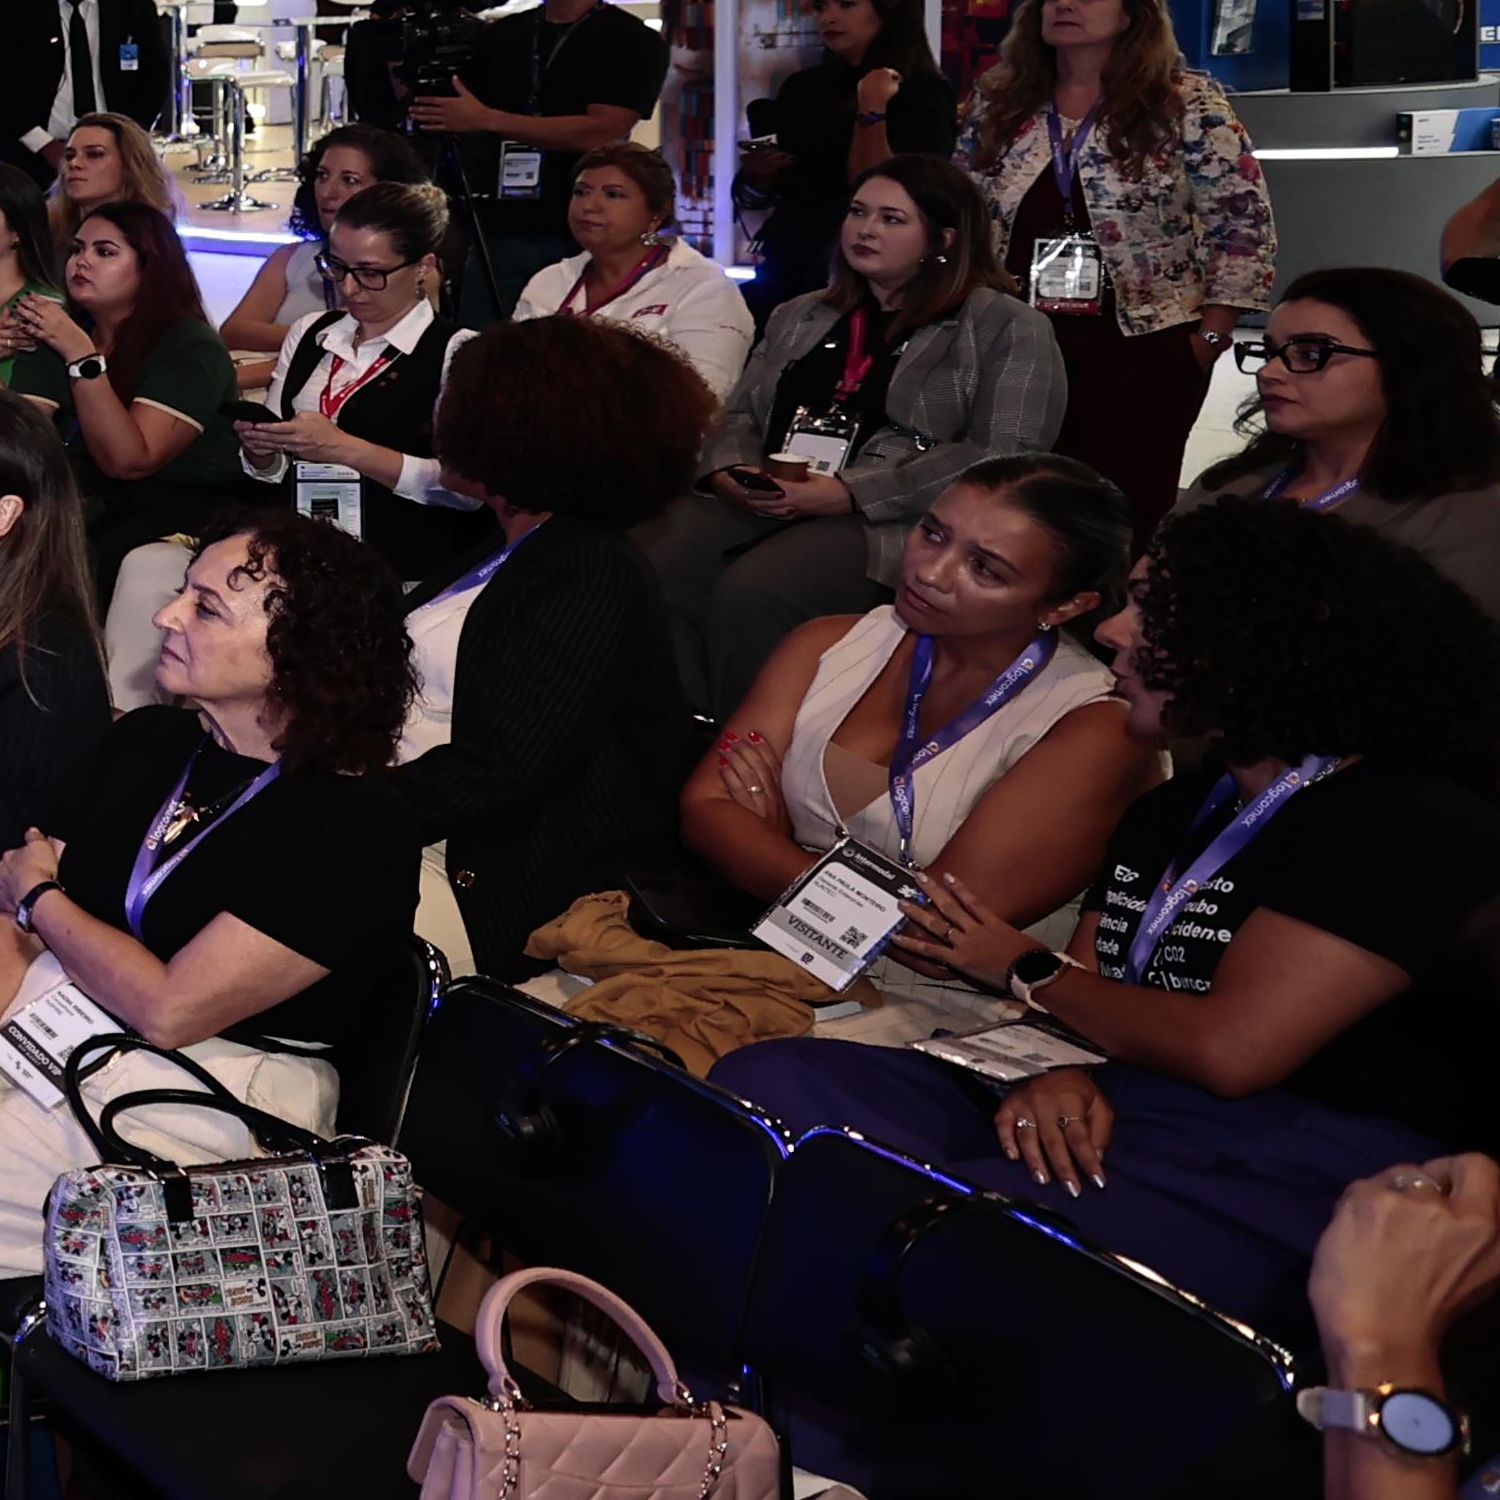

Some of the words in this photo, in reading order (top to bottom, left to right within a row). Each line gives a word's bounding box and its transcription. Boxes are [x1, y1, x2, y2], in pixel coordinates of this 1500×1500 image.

[984, 665, 1029, 707] logcomex
[1241, 779, 1292, 828] logcomex
[1146, 889, 1190, 935] logcomex
[787, 914, 848, 960] VISITANTE
[8, 1025, 50, 1066] CONVIDADO
[48, 1063, 63, 1077] VIP
